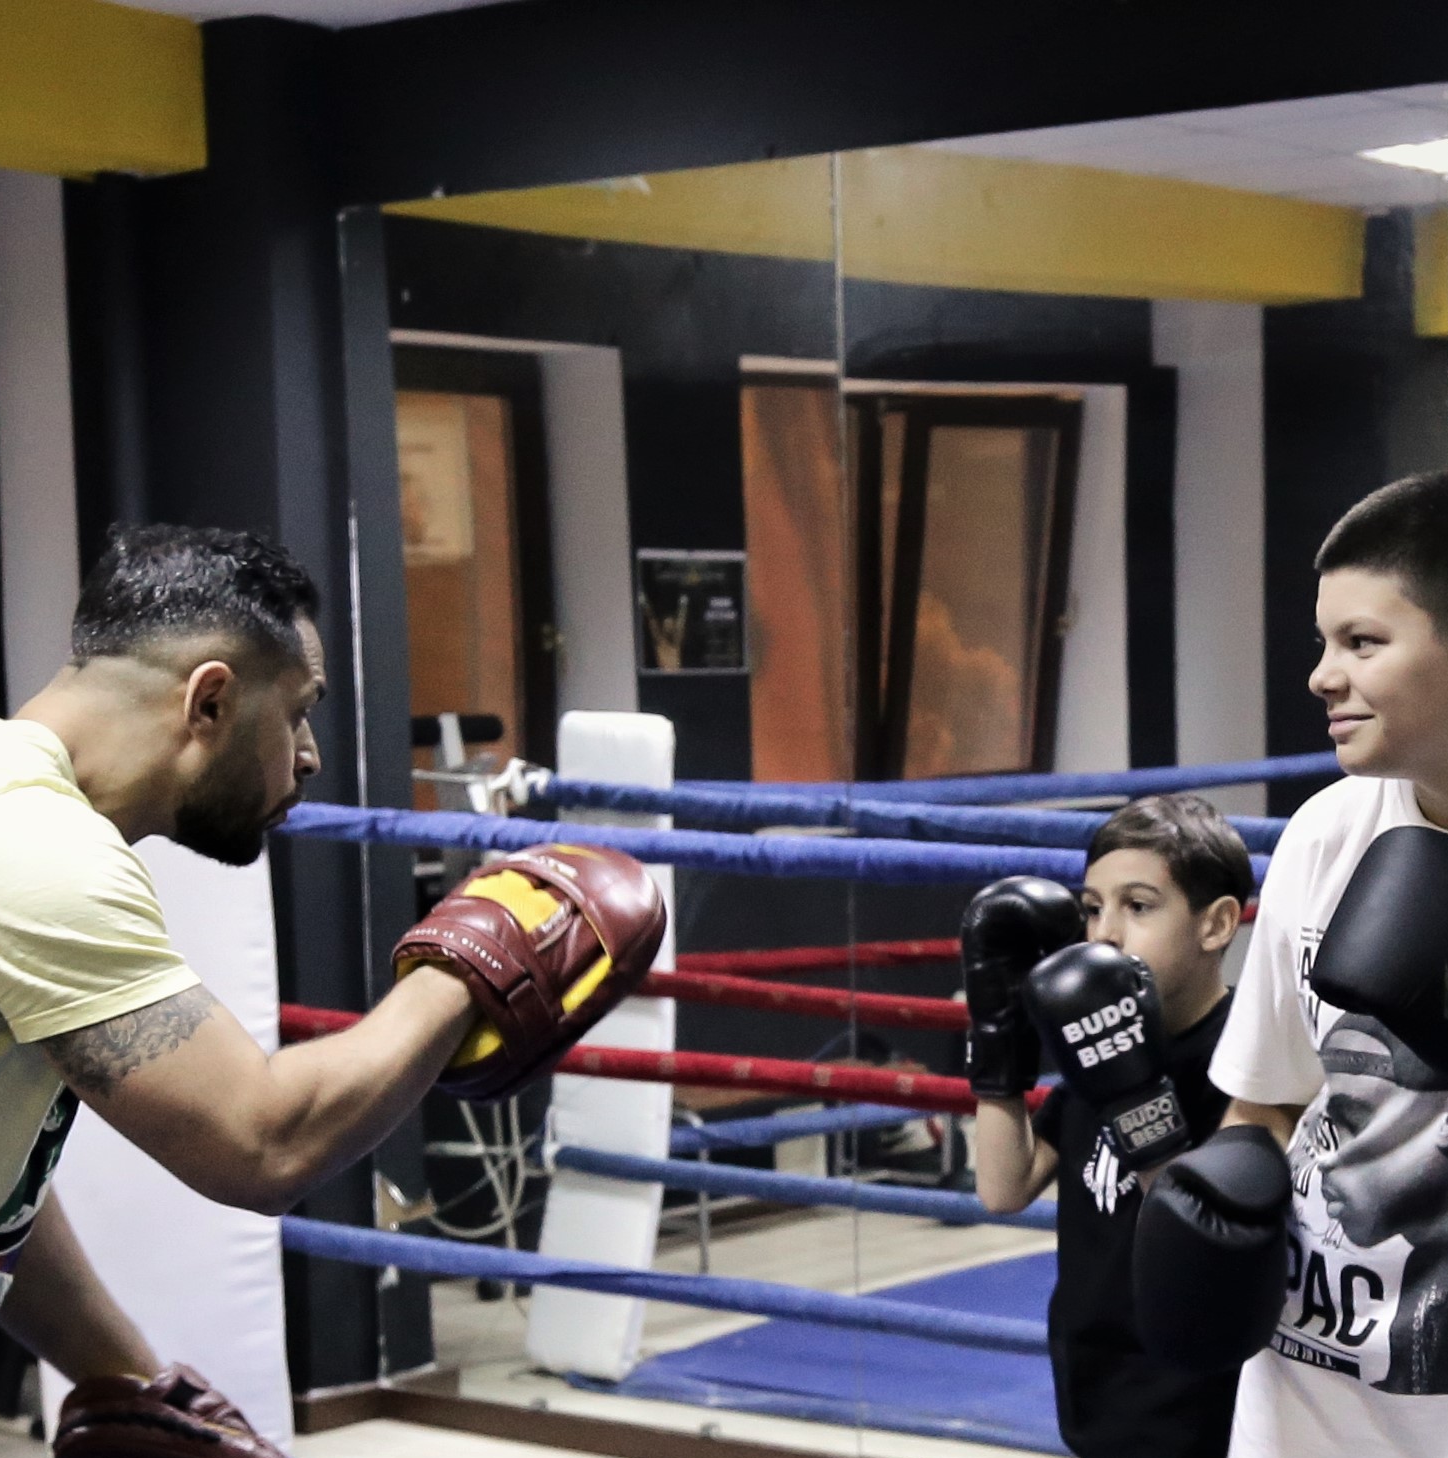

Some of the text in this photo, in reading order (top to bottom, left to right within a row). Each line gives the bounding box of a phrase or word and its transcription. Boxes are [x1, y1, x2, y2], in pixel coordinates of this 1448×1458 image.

[1062, 996, 1138, 1044] BUDO
[1077, 1021, 1145, 1069] BEST
[1119, 1098, 1173, 1135] BUDO
[1130, 1115, 1176, 1149] BEST
